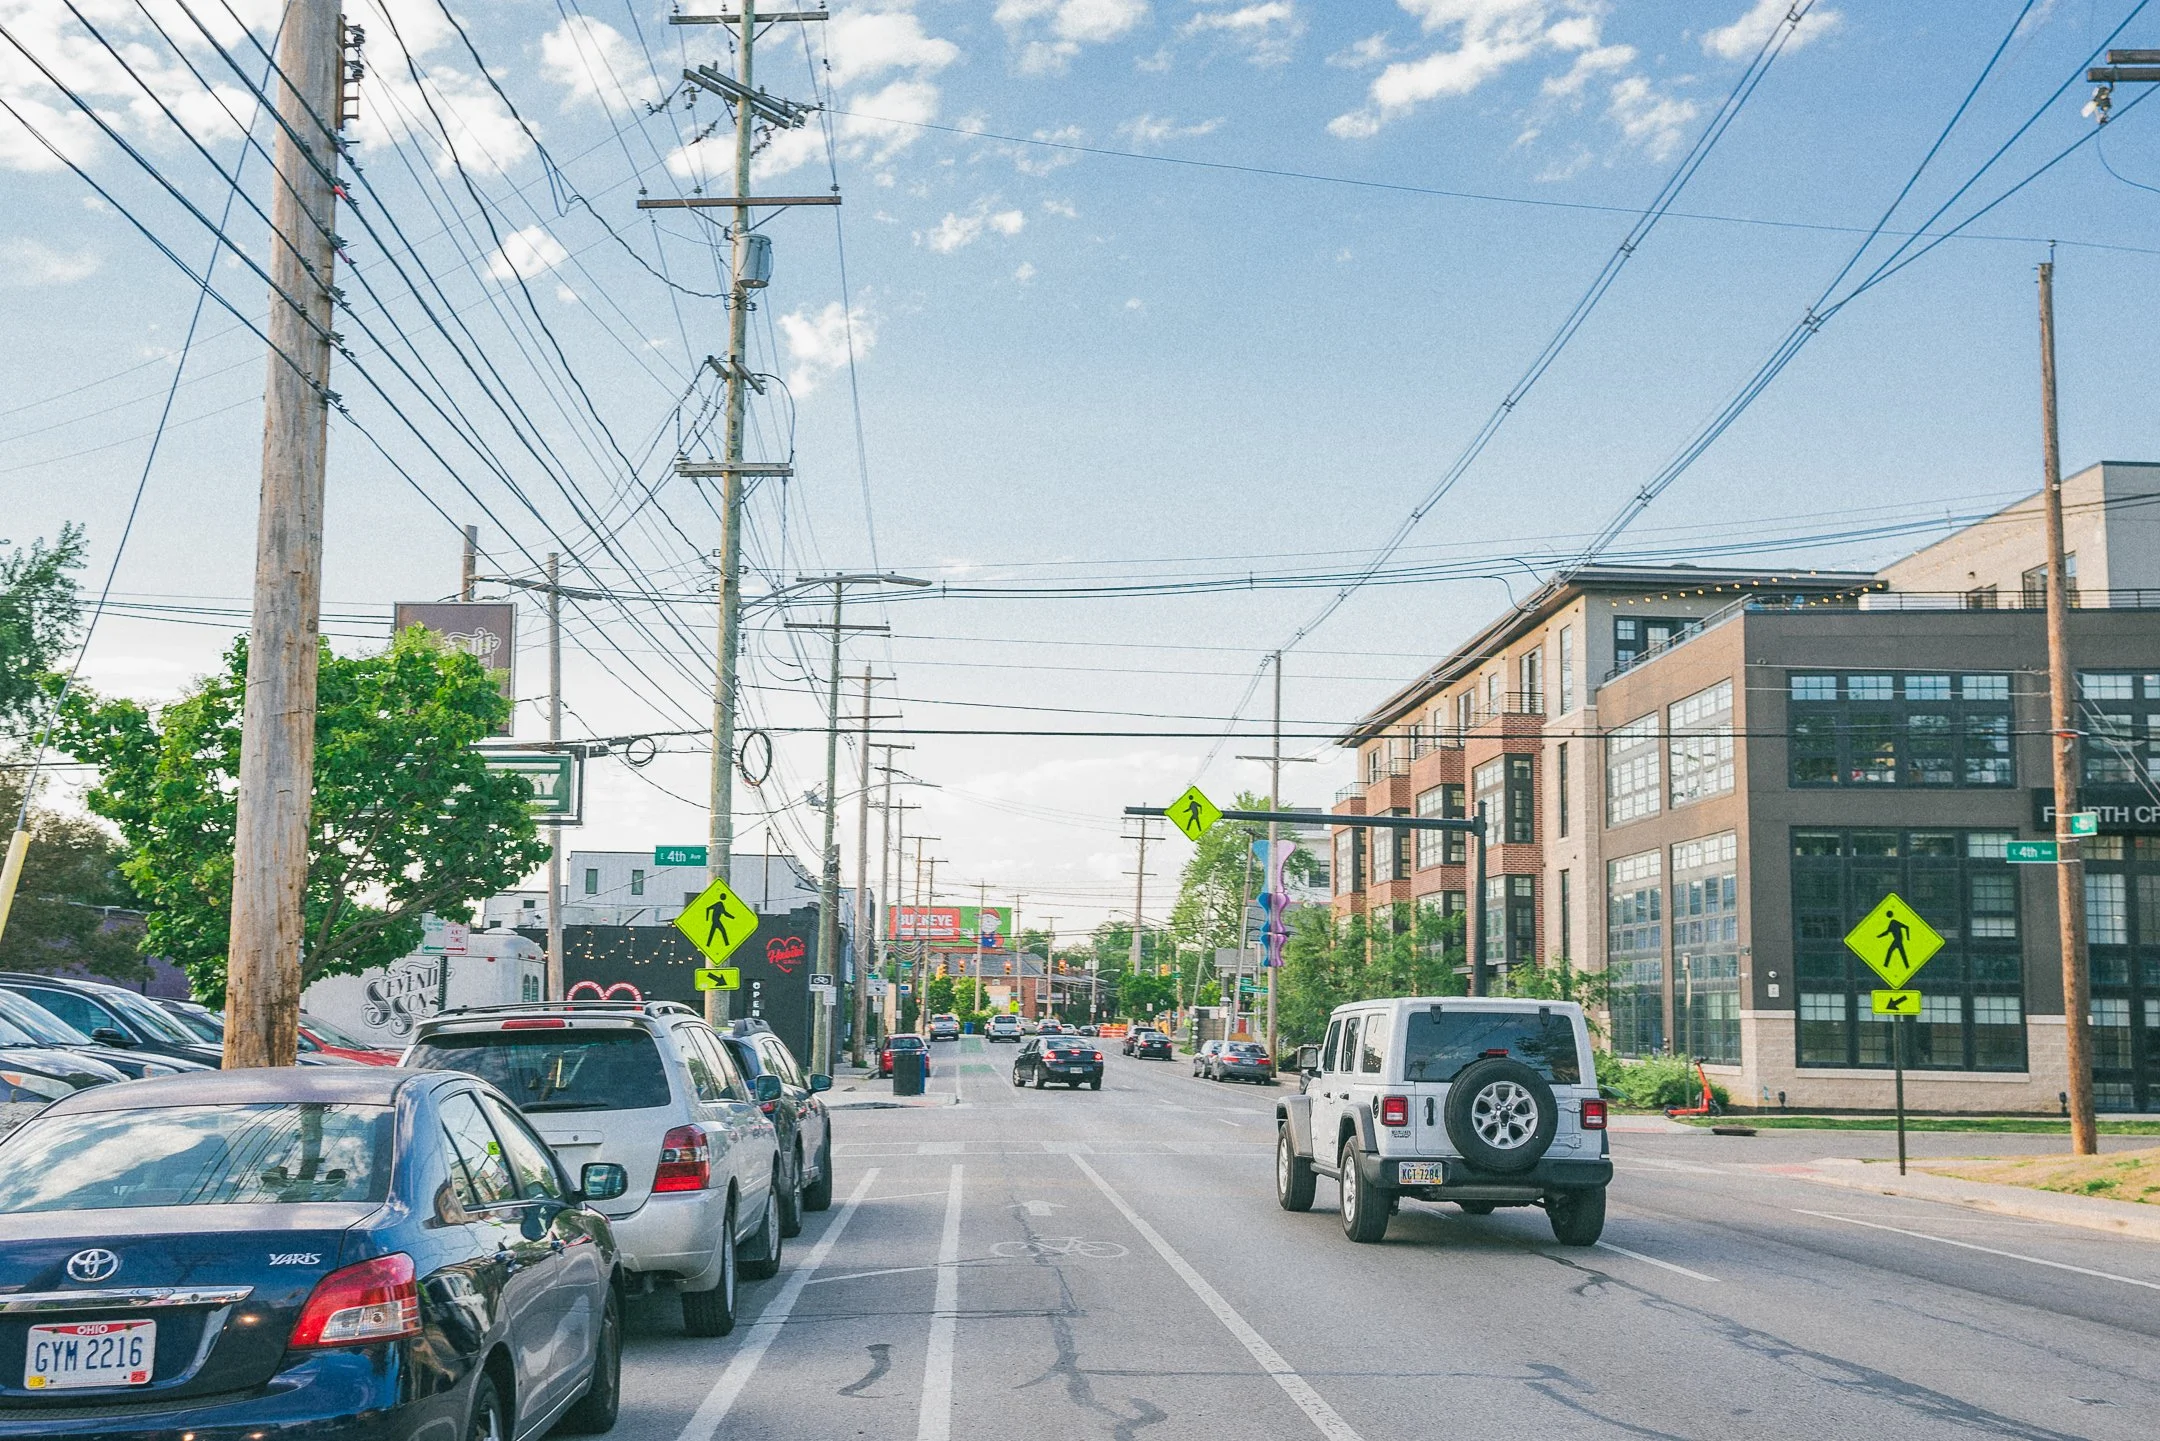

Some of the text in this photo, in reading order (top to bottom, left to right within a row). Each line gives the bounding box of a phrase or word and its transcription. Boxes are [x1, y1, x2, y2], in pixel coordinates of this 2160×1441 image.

[2043, 806, 2128, 822] FRTH
[660, 852, 665, 860] E
[667, 850, 687, 862] 4th
[2019, 846, 2038, 858] 4th
[752, 982, 761, 1017] OPEN
[391, 992, 428, 1036] SON
[1402, 1168, 1417, 1180] KCT
[269, 1253, 322, 1266] YARIS
[77, 1324, 108, 1335] OHIO
[35, 1336, 143, 1372] GYM 2216
